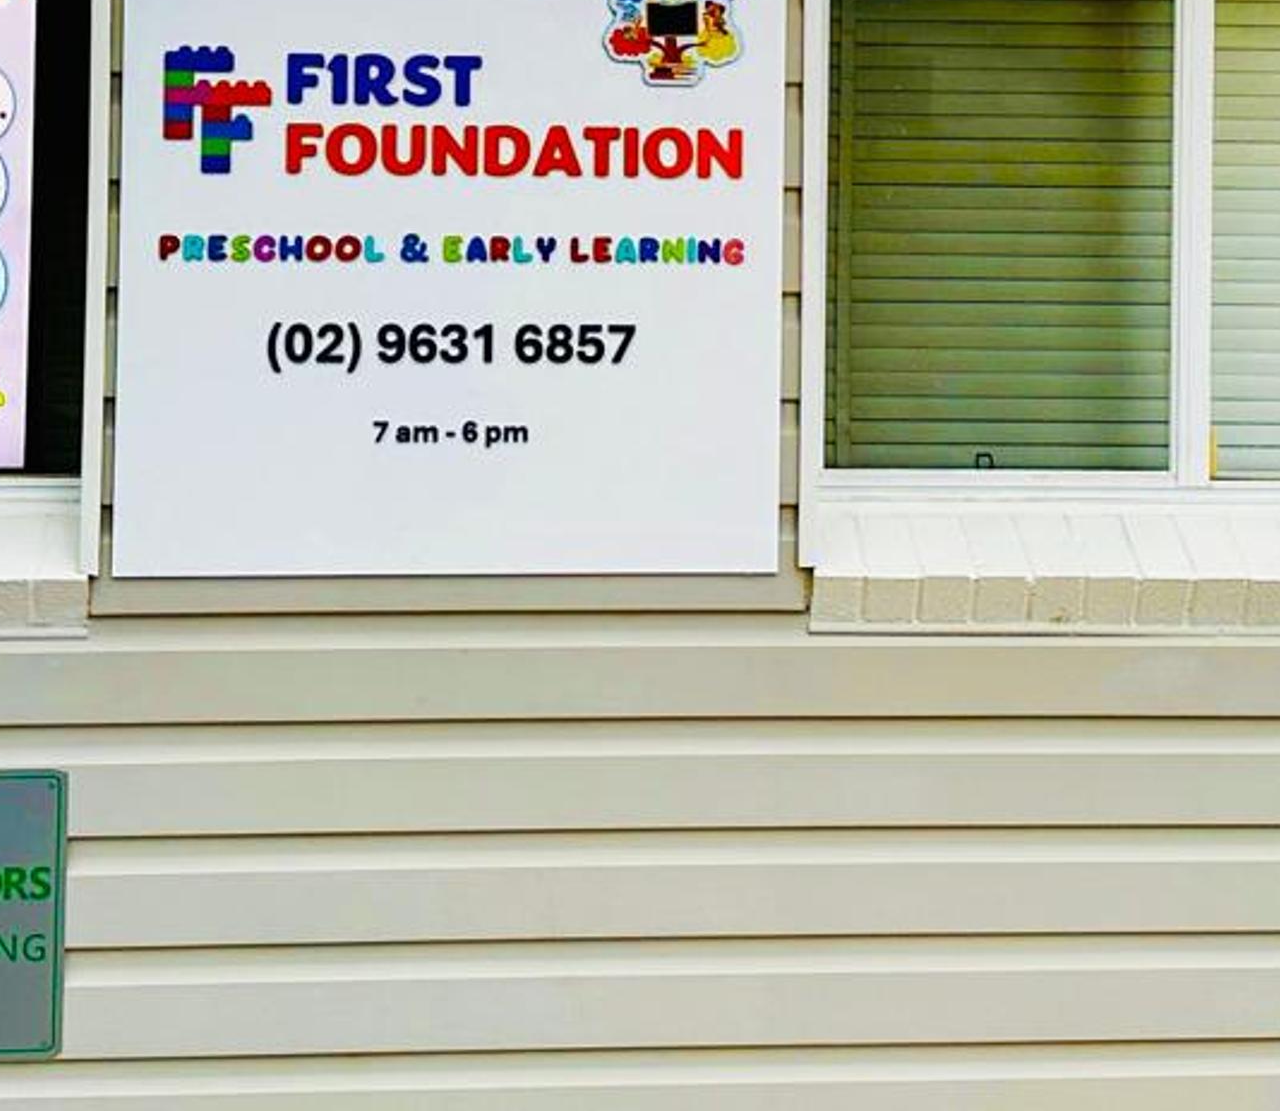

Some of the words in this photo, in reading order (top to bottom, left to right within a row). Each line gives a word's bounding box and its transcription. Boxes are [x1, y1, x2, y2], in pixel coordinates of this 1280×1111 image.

[285, 122, 744, 180] FOUNDATION
[159, 234, 385, 264] PRESCHOOL
[400, 234, 430, 265] &
[443, 235, 558, 265] EARLY
[570, 236, 746, 267] LEARNING
[267, 322, 361, 373] (02)
[377, 324, 494, 365] 9631
[515, 324, 637, 365] 6857
[373, 422, 389, 444] 7
[396, 426, 439, 444] am
[462, 422, 479, 445] 6
[485, 427, 530, 450] pm
